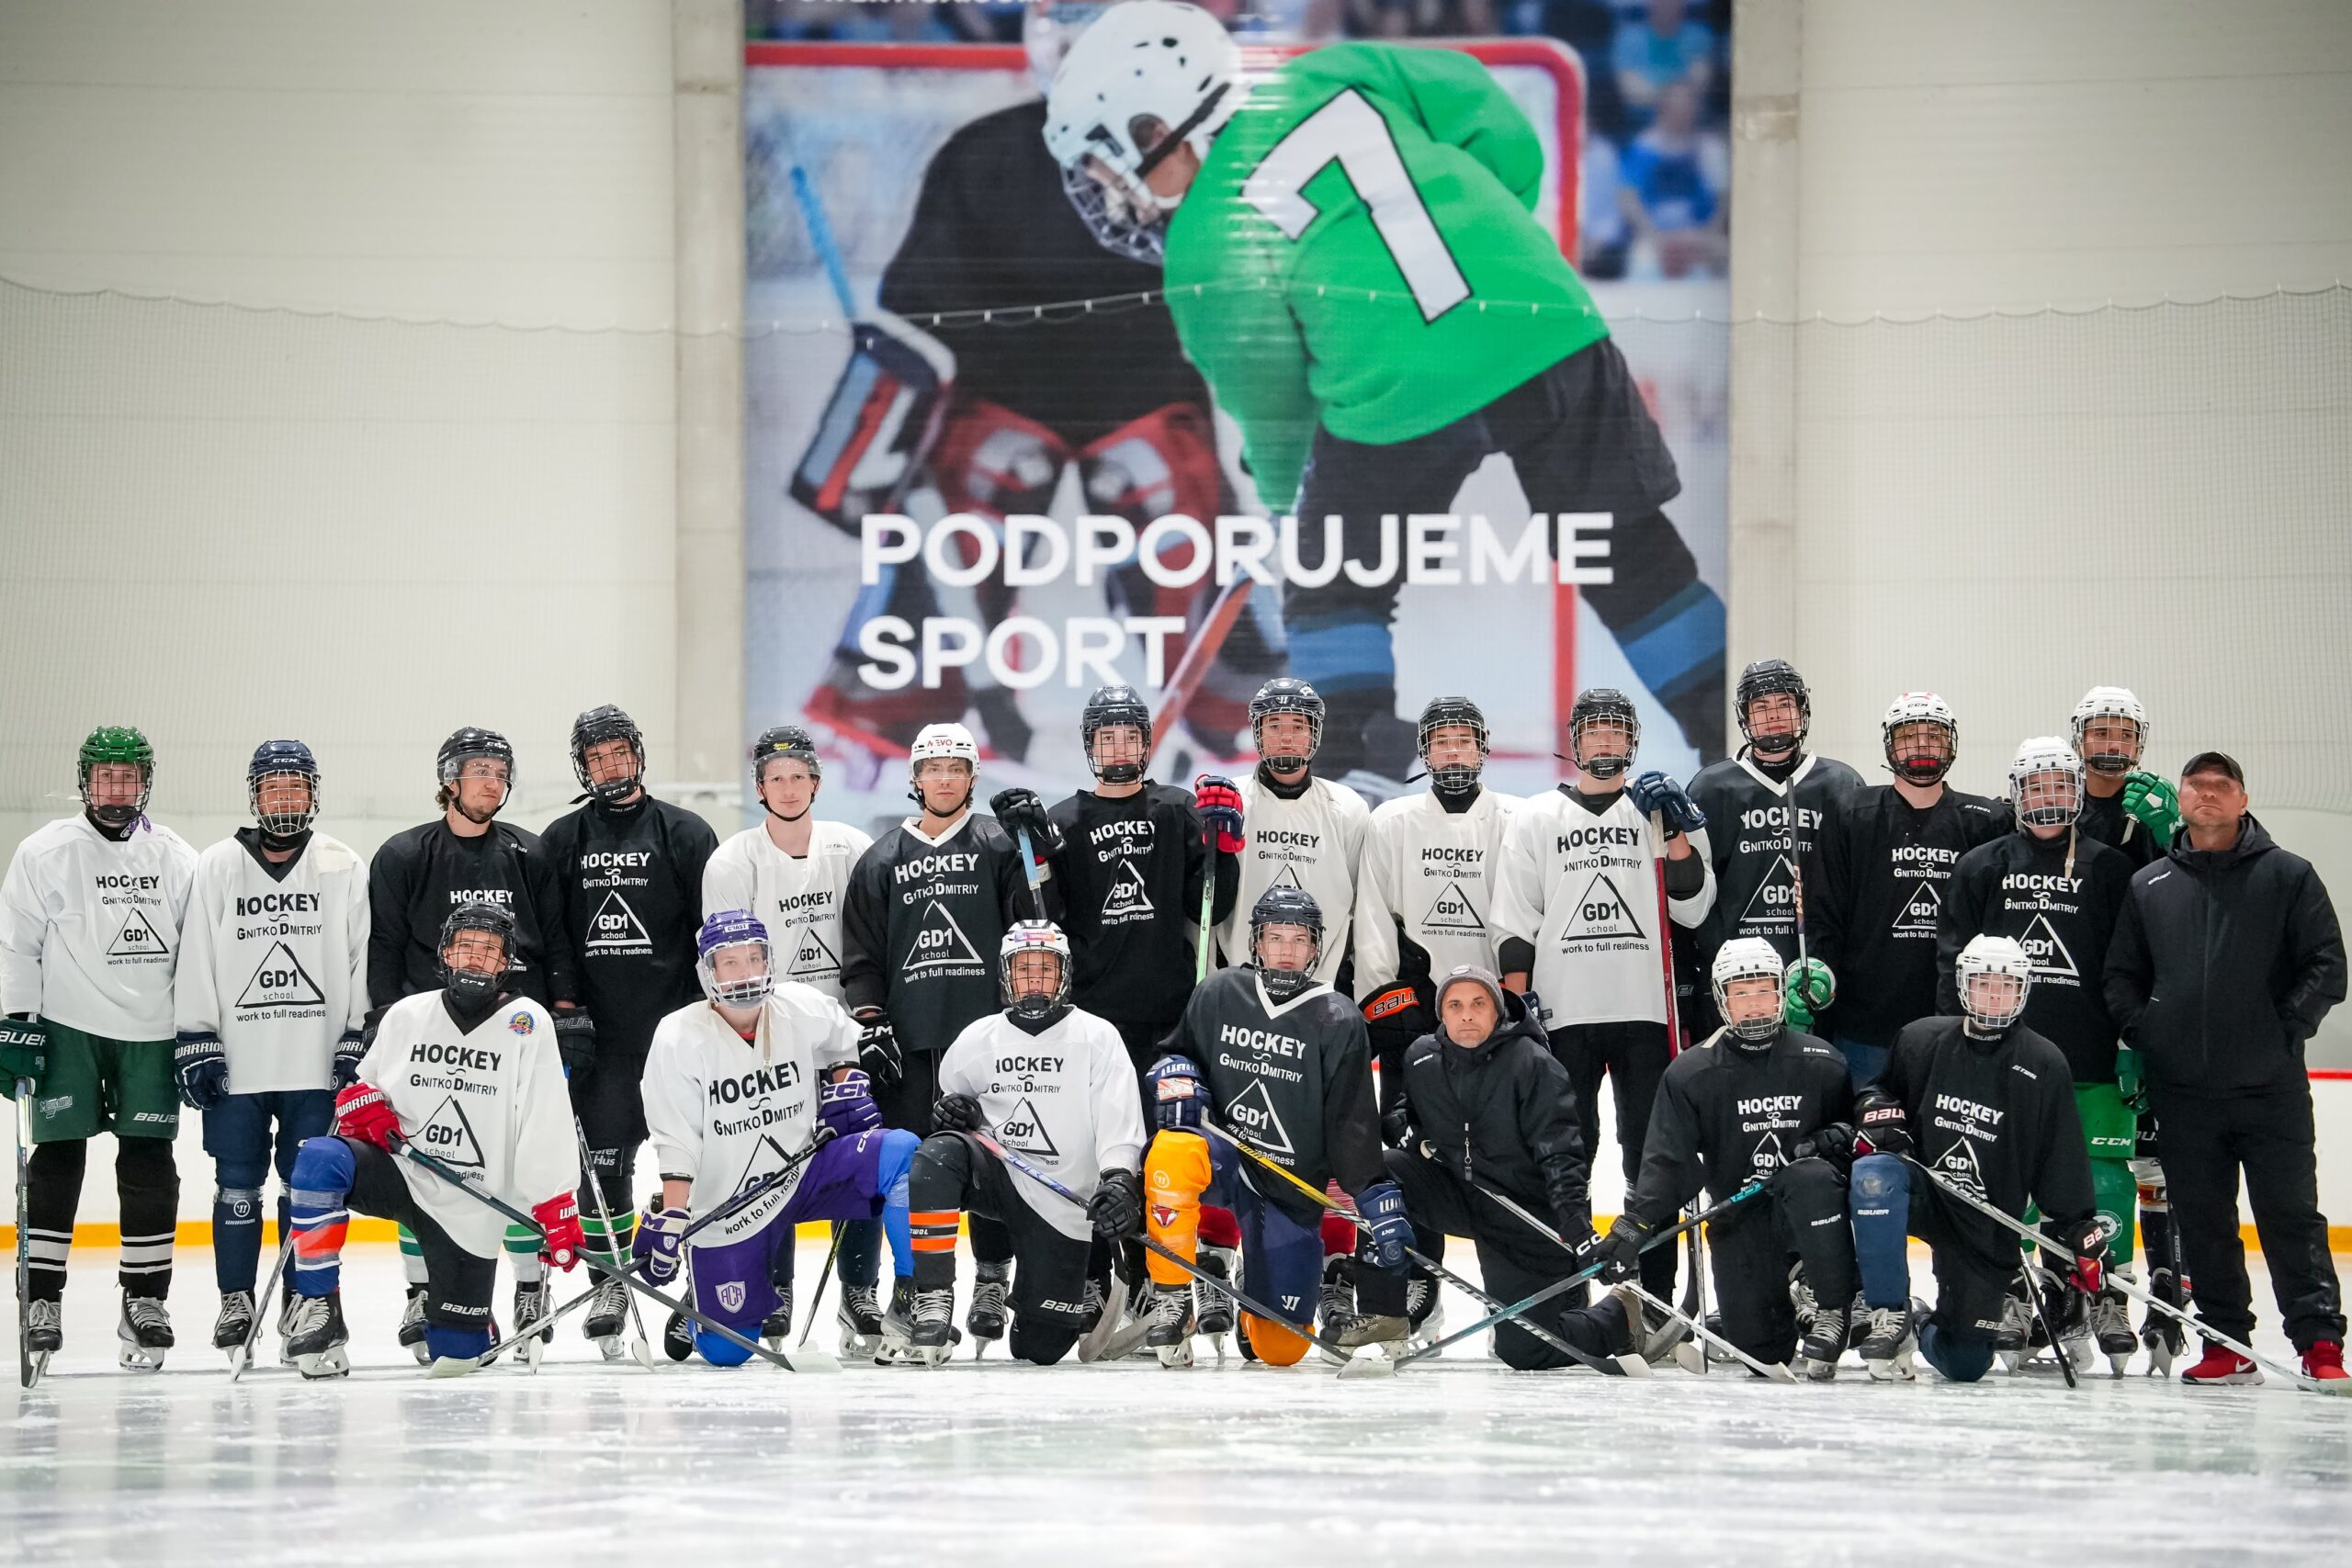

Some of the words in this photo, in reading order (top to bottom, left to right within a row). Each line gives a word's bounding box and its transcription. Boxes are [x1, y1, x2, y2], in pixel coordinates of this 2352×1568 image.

[1240, 85, 1473, 323] 7
[861, 512, 1614, 589] PODPORUJEME
[857, 615, 1185, 690] SPORT
[605, 785, 628, 796] CCM
[1090, 821, 1155, 845] HOCKEY
[1257, 830, 1319, 848] HOCKEY
[1557, 827, 1639, 853] HOCKEY
[1740, 840, 1781, 853] GNITKO
[580, 852, 650, 870] HOCKEY
[1259, 851, 1287, 860] GNITKO
[1289, 852, 1317, 864] DMITRIY
[1422, 848, 1484, 862] HOCKEY
[1600, 855, 1642, 869] DMITRIY
[1892, 847, 1960, 863] HOCKEY
[895, 854, 979, 884] HOCKEY
[1424, 868, 1452, 877] GNITKO
[1453, 869, 1481, 878] DMITRIY
[1894, 868, 1925, 877] GNITKO
[96, 875, 159, 889] HOCKEY
[582, 878, 610, 889] GNITKO
[612, 875, 648, 886] DMITRIY
[935, 883, 979, 895] DMITRIY
[1792, 864, 1804, 914] CCM
[2002, 874, 2083, 893] HOCKEY
[450, 889, 513, 904] HOCKEY
[1114, 882, 1138, 898] GD1
[1763, 886, 1796, 904] GD1
[102, 897, 132, 905] GNITKO
[133, 895, 161, 906] DMITRIY
[237, 893, 320, 916] HOCKEY
[779, 891, 832, 912] HOCKEY
[1113, 897, 1134, 908] school
[1437, 902, 1464, 914] GD1
[2005, 898, 2037, 909] GNITKO
[2040, 898, 2079, 914] DMITRIY
[809, 913, 835, 922] DMITRIY
[1583, 901, 1619, 921] GD1
[1767, 908, 1794, 916] school
[1910, 903, 1938, 917] GD1
[599, 914, 628, 930] GD1
[1587, 924, 1617, 933] school
[124, 929, 149, 942] GD1
[237, 926, 277, 940] GNITKO
[280, 923, 322, 935] DMITRIY
[1739, 926, 1760, 935] work
[1764, 926, 1772, 934] to
[1775, 926, 1789, 934] full
[919, 928, 952, 949] GD1
[800, 947, 820, 961] GD1
[922, 950, 949, 960] school
[1562, 944, 1582, 954] work
[1596, 942, 1610, 951] full
[1613, 941, 1649, 950] readiness
[2022, 940, 2053, 955] GD1
[260, 969, 297, 988] GD1
[460, 978, 486, 987] CCM
[905, 973, 919, 984] work
[920, 970, 926, 978] to
[929, 967, 943, 977] full
[945, 967, 985, 976] readiness
[2043, 976, 2080, 987] readiness
[264, 991, 294, 1000] school
[1265, 987, 1290, 996] CCM
[1374, 990, 1419, 1016] BAU
[236, 1012, 259, 1021] work
[274, 1010, 286, 1018] full
[0, 1031, 46, 1046] AUER
[1220, 1024, 1306, 1059] HOCKEY
[410, 1044, 501, 1071] HOCKEY
[1219, 1053, 1259, 1074] GNITKO
[1261, 1063, 1303, 1083] DMITRIY
[411, 1074, 452, 1089] GNITKO
[454, 1078, 497, 1095] DMITRIY
[709, 1061, 800, 1106] HOCKEY
[820, 1082, 870, 1100] CCM
[991, 1083, 1022, 1093] GNITKO
[1024, 1081, 1060, 1093] DMITRIY
[336, 1091, 385, 1117] WARRIOR
[1737, 1096, 1803, 1115] HOCKEY
[1936, 1094, 2004, 1124] HOCKEY
[714, 1116, 761, 1136] GNITKO
[763, 1100, 805, 1125] DMITRIY
[1233, 1104, 1269, 1129] GD1
[1862, 1108, 1906, 1123] BAU
[1003, 1122, 1035, 1137] GD1
[1934, 1116, 1964, 1133] GNITKO
[426, 1124, 462, 1146] GD1
[2091, 1136, 2132, 1146] CCM
[424, 1148, 455, 1158] school
[594, 1155, 616, 1166] Hus
[1753, 1154, 1779, 1167] GD1
[1945, 1156, 1973, 1171] GD1
[725, 1216, 752, 1235] work
[751, 1208, 763, 1221] to
[763, 1194, 780, 1211] full
[1811, 1213, 1841, 1226] BAUER
[721, 1284, 742, 1307] ACA
[440, 1303, 489, 1316] BAUER
[1039, 1299, 1083, 1314] BAUE
